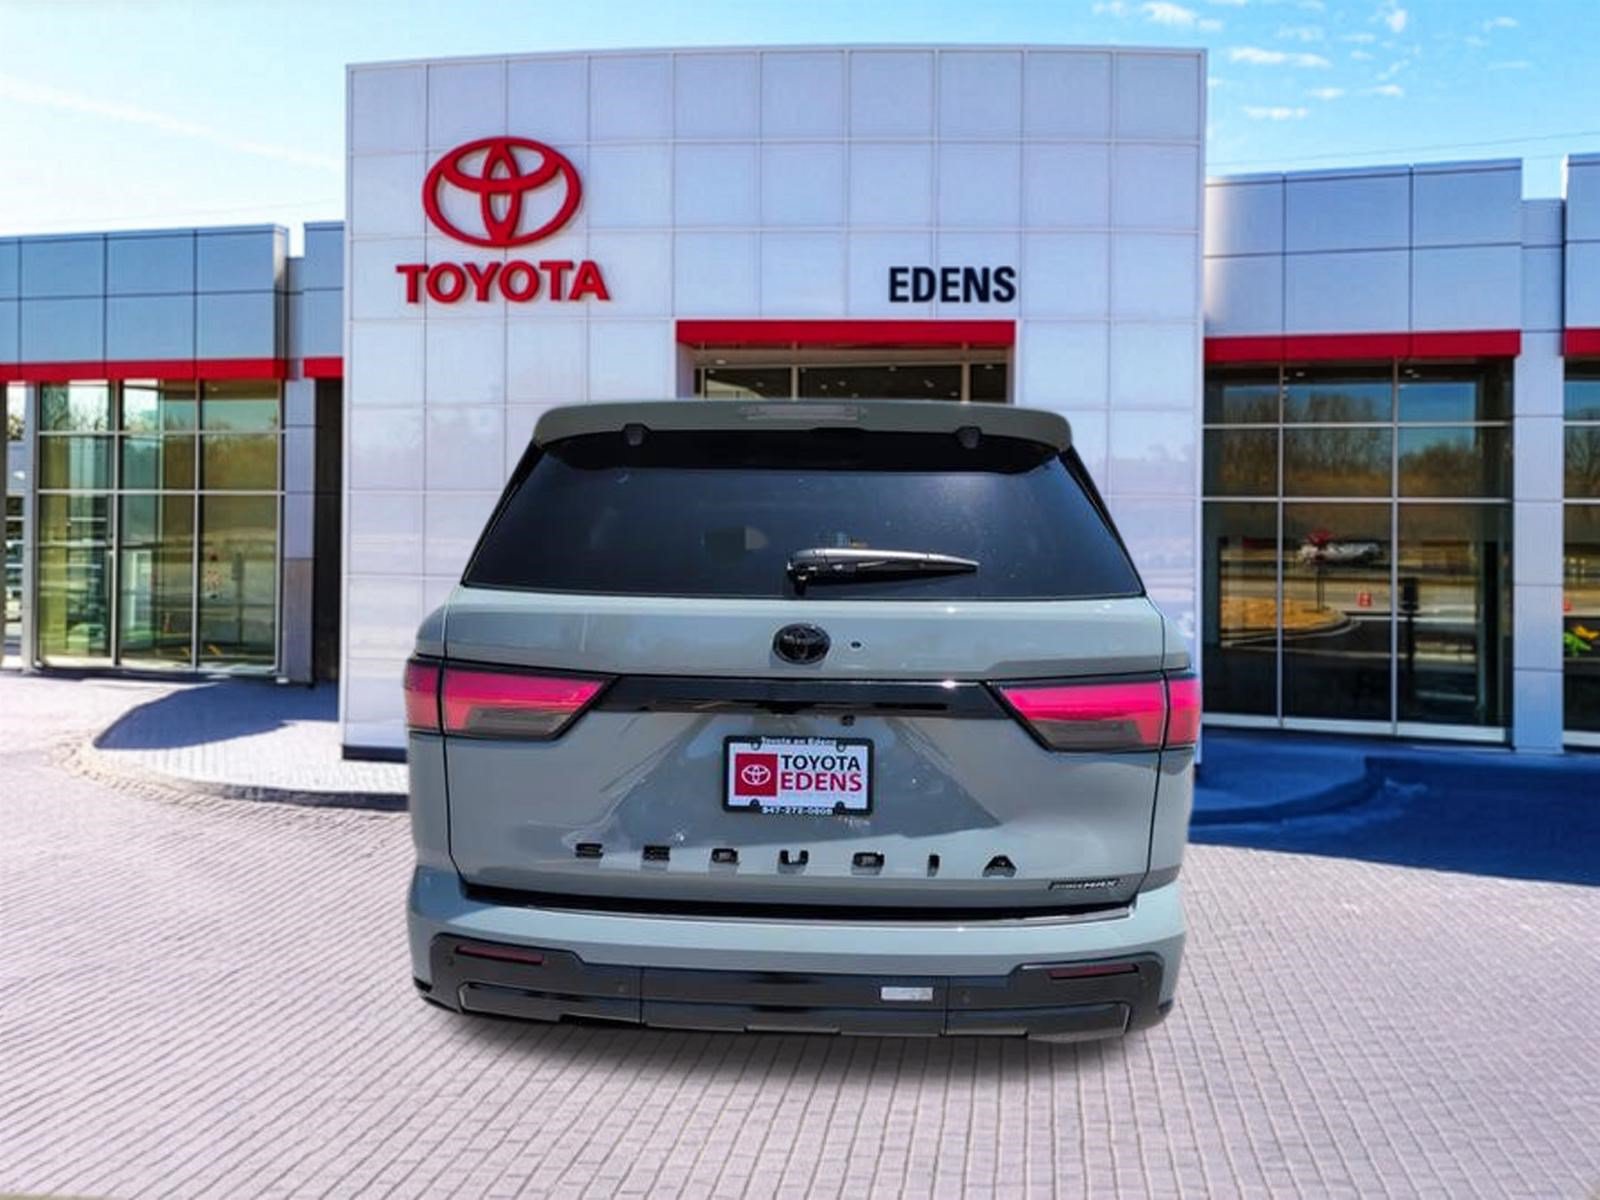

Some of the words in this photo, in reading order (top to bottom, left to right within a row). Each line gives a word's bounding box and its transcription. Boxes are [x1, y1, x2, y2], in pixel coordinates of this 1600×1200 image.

[397, 260, 610, 304] TOYOTA
[889, 266, 1017, 303] EDENS
[780, 755, 860, 770] TOYOTA
[780, 772, 863, 792] EDENS
[574, 842, 1018, 878] SEQUOIA
